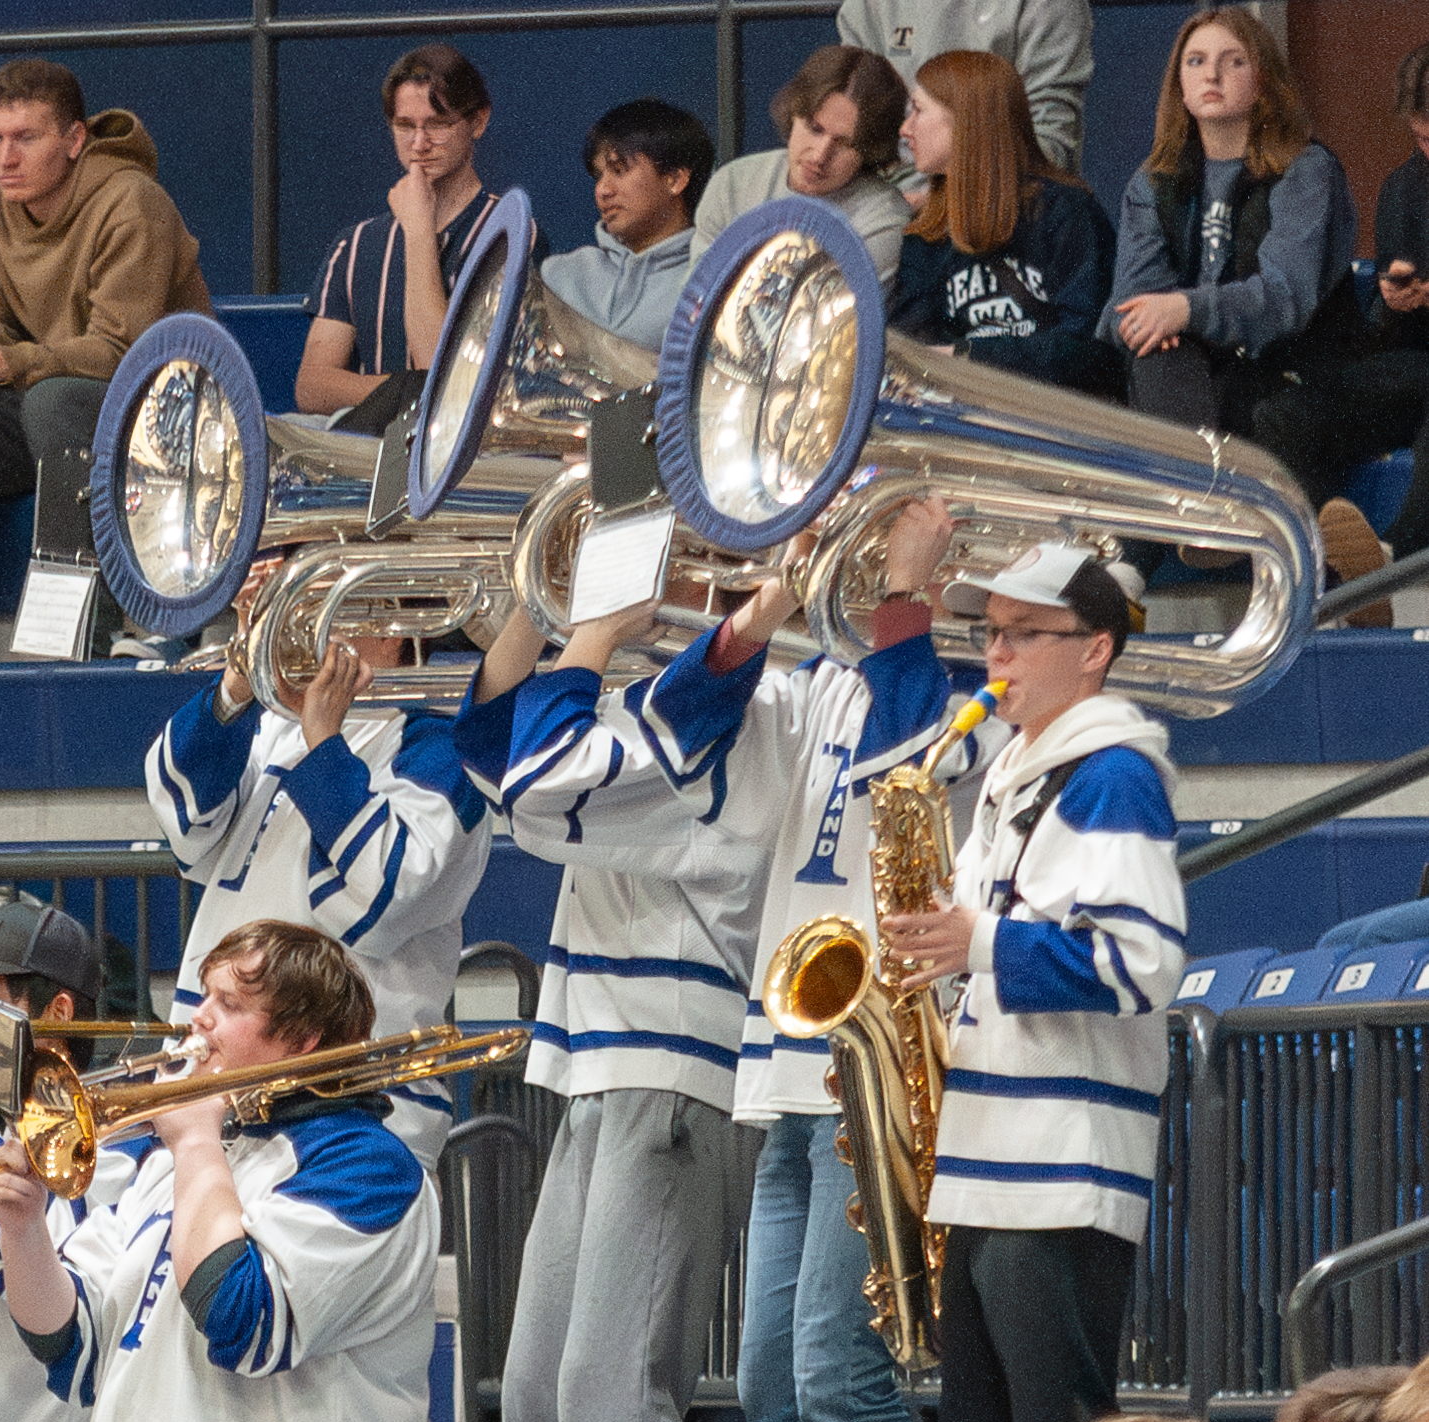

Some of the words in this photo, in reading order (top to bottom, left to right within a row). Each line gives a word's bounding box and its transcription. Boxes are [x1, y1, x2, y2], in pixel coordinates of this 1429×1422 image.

[894, 26, 913, 46] T
[946, 257, 1049, 318] SEATLE
[815, 770, 851, 857] BAND
[1192, 977, 1202, 992] 1
[1271, 975, 1282, 991] 2
[1350, 969, 1362, 986] 3
